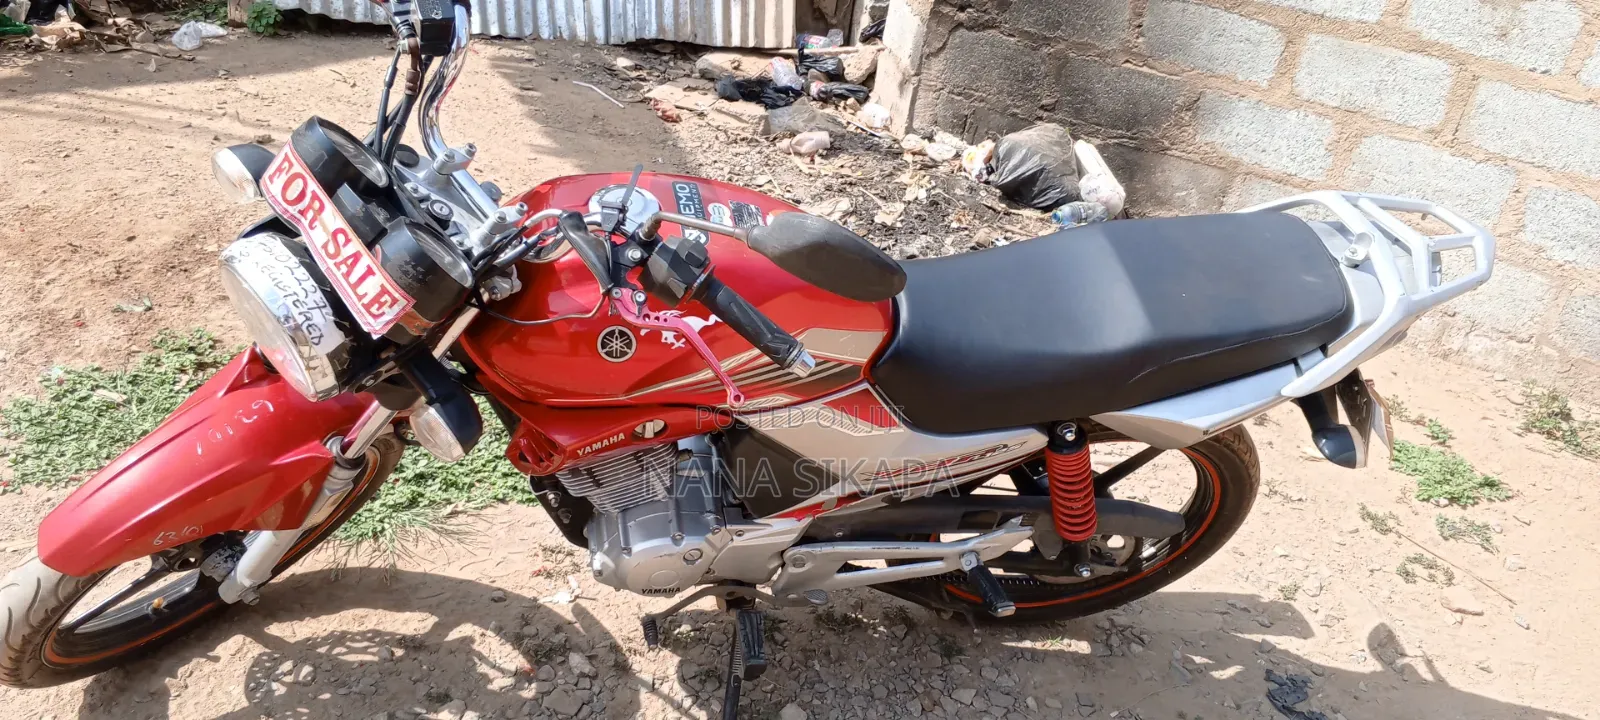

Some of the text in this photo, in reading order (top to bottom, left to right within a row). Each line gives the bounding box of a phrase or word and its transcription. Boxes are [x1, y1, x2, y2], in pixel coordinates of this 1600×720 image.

[676, 183, 697, 219] EMO
[267, 152, 400, 323] FOR SALE
[577, 432, 626, 456] YAMAHA
[641, 586, 681, 595] YAMAHA
